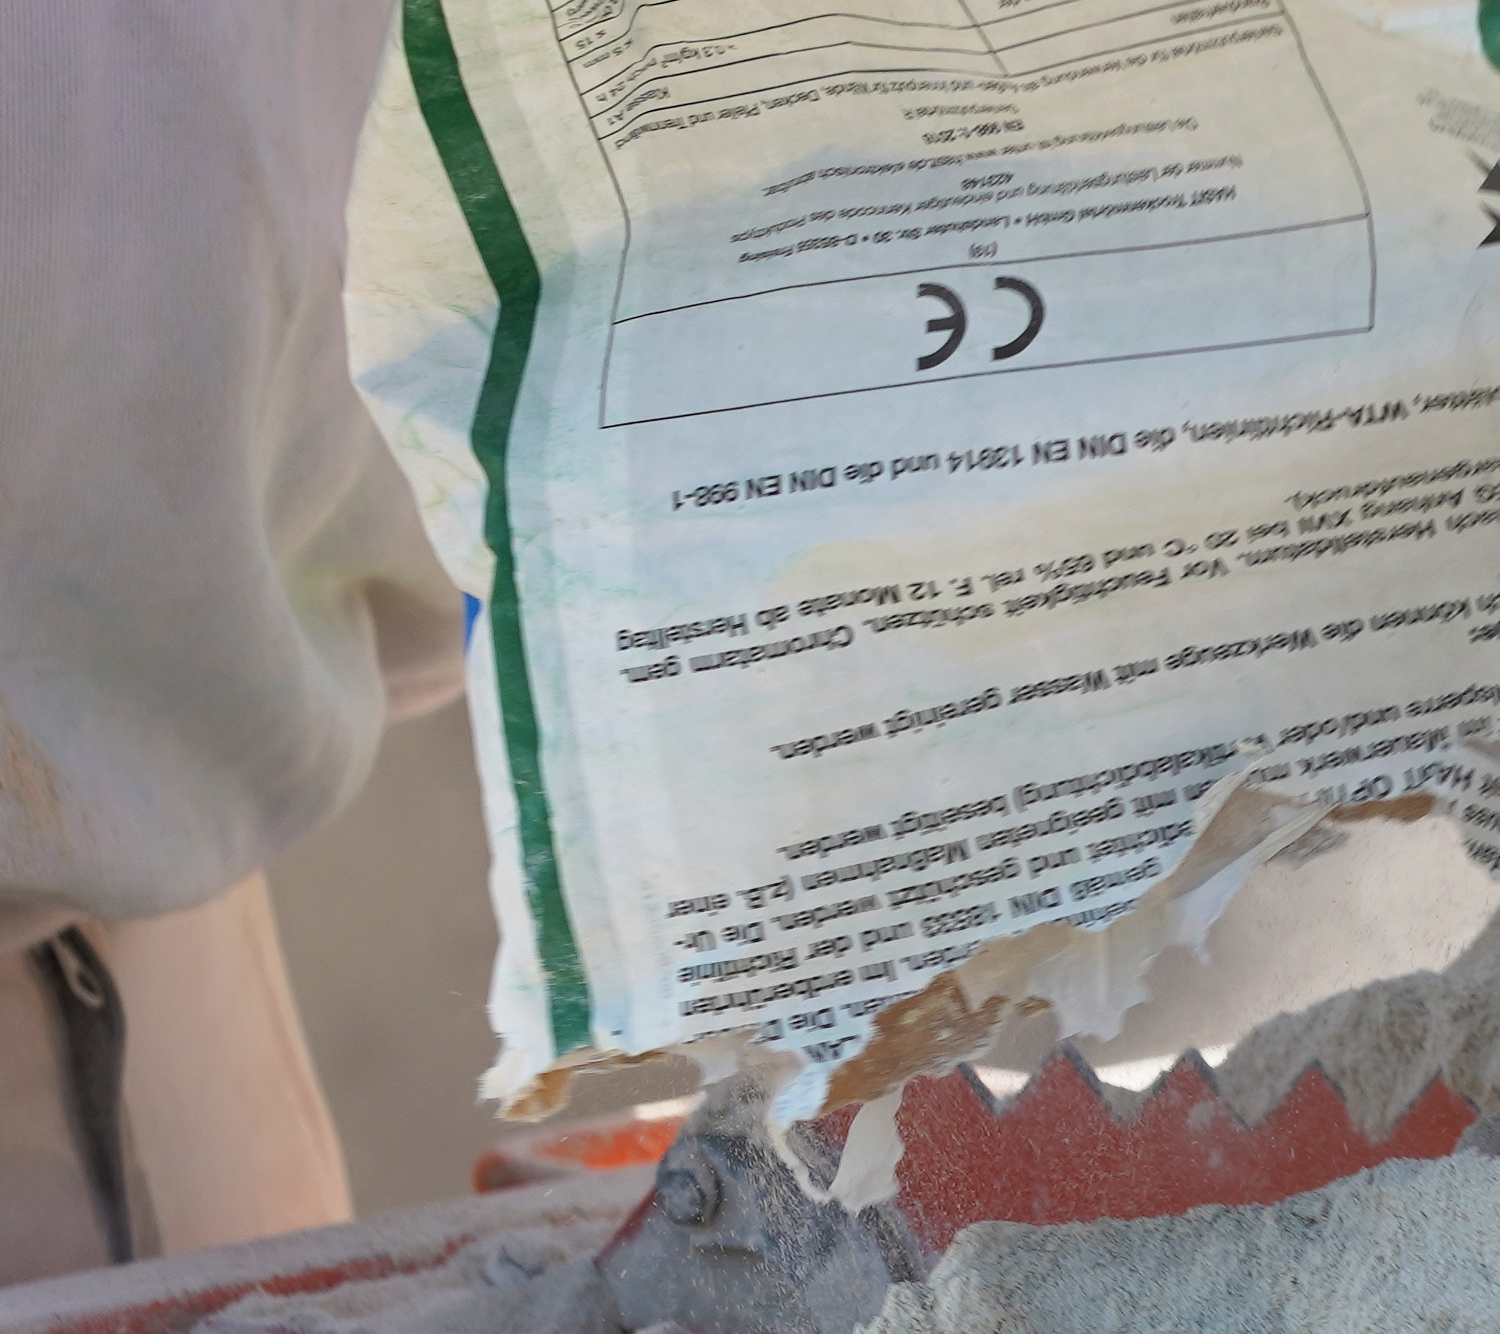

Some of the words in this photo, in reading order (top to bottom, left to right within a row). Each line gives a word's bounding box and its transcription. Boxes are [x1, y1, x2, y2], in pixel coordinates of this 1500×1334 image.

[685, 111, 715, 129] und
[1032, 439, 1070, 464] EN
[1078, 433, 1127, 459] DIN
[1134, 427, 1176, 451] die
[790, 466, 836, 492] DIN
[844, 460, 884, 484] die
[891, 453, 940, 480] und
[673, 481, 739, 510] 998-1
[745, 474, 782, 499] EN
[1205, 530, 1239, 550] 20
[1246, 520, 1290, 542] bei
[1034, 554, 1095, 581] 65%
[1102, 543, 1154, 568] und
[1180, 558, 1229, 579] Vor
[907, 581, 941, 601] 12
[949, 577, 973, 598] F.
[981, 568, 1025, 592] rel.
[1005, 569, 1170, 616] Feuchtigkeit
[798, 585, 901, 616] Monate
[756, 605, 789, 630] ab
[864, 603, 994, 633] schützen.
[1370, 600, 1470, 631] können
[1322, 618, 1364, 641] die
[1166, 629, 1316, 669] Werkzeuge
[1113, 659, 1159, 684] mit
[1009, 670, 1109, 704] Wasser
[885, 687, 1001, 735] gereinigt
[1278, 706, 1400, 746] und/oder
[772, 724, 878, 759] werden.
[1132, 789, 1177, 816] mit
[891, 795, 1008, 839] beseitigt
[978, 797, 1124, 850] geeigneten
[779, 825, 885, 860] werden.
[803, 840, 969, 890] Maßnahmen
[1028, 847, 1079, 877] und
[888, 857, 1019, 908] geschützt
[668, 893, 730, 918] einer
[773, 896, 877, 931] werden.
[1009, 886, 1061, 915] DIN
[673, 929, 716, 952] Ur-
[723, 921, 765, 944] Die
[860, 922, 910, 952] und
[806, 935, 852, 960] der
[680, 948, 798, 983] Richtlinie
